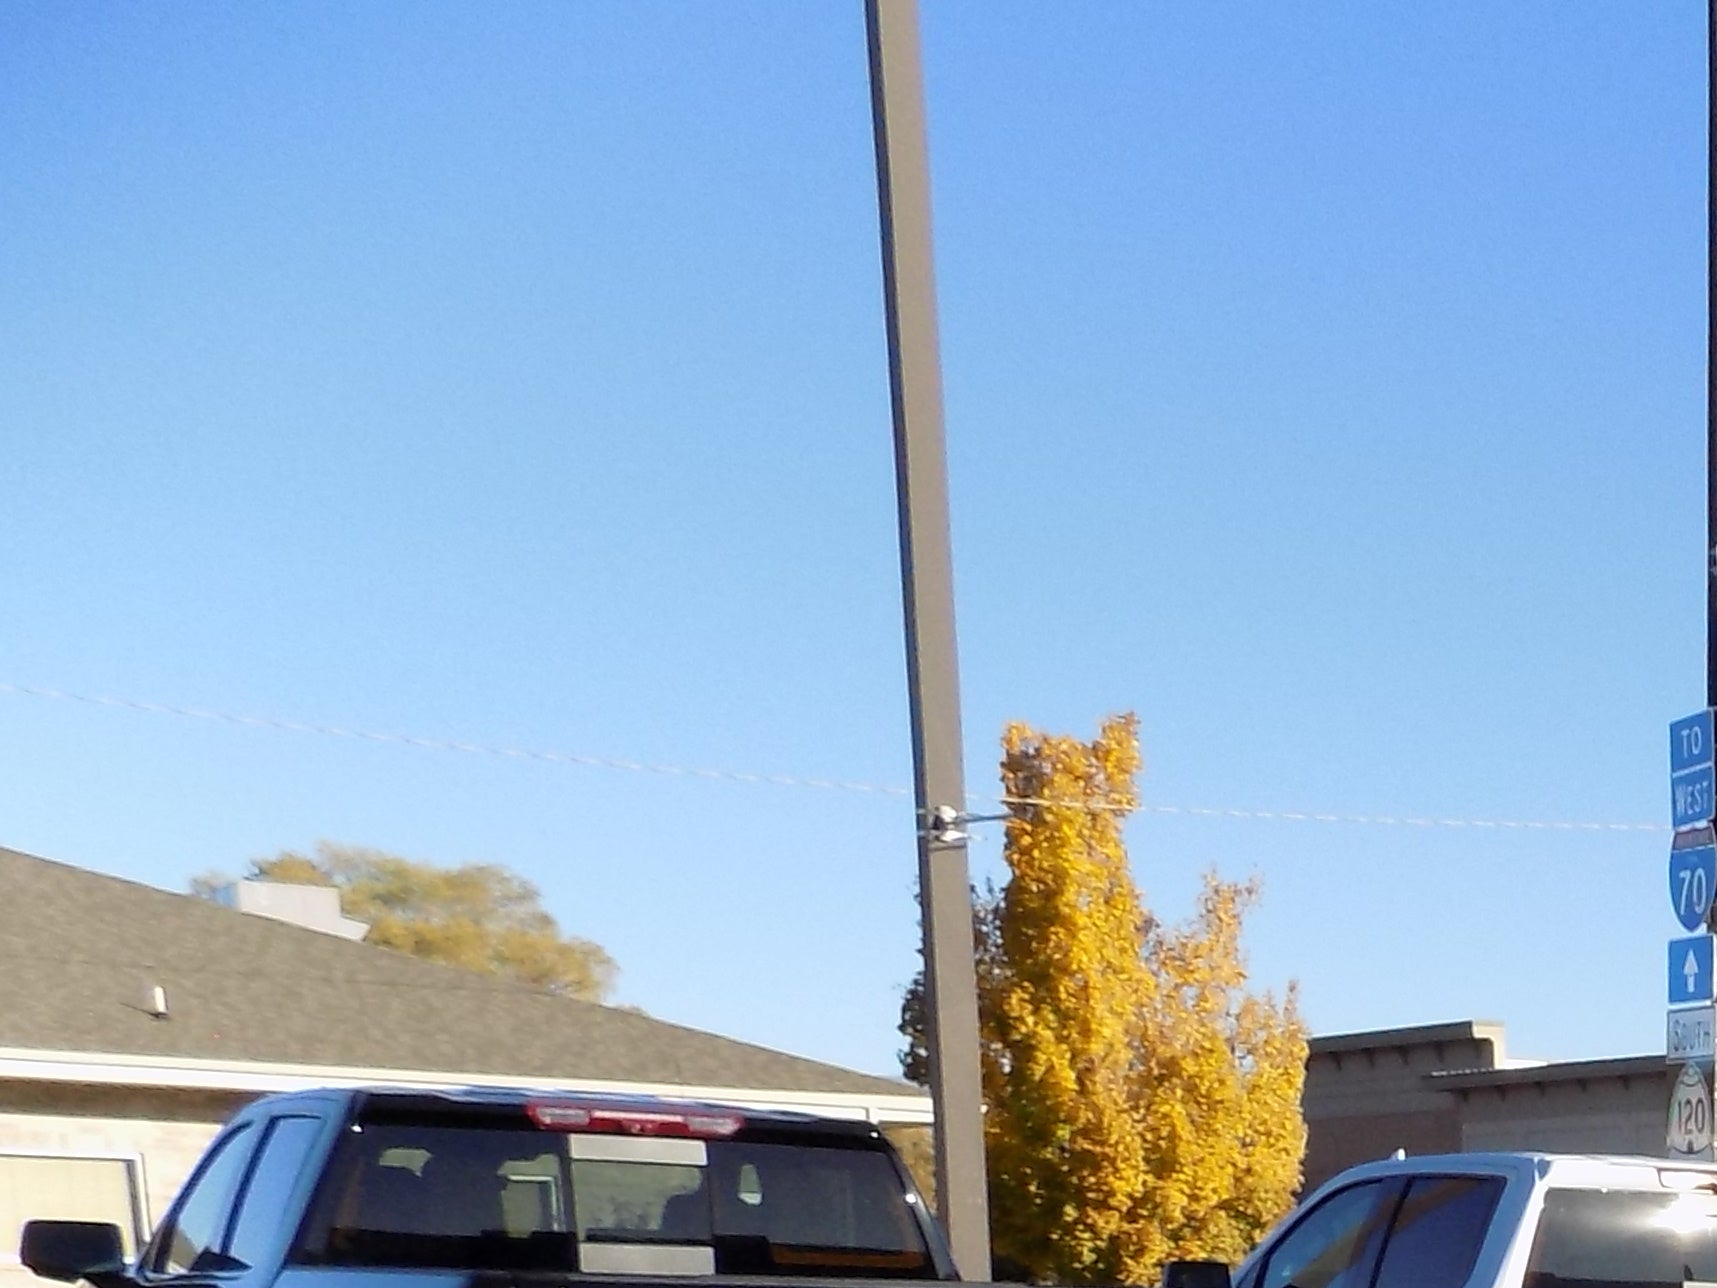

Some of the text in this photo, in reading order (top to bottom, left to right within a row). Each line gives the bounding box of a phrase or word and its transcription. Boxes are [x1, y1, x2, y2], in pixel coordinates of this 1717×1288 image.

[1681, 726, 1701, 760] TO
[1675, 780, 1709, 817] WEST
[1679, 867, 1707, 916] 70
[1677, 1097, 1706, 1136] 120
